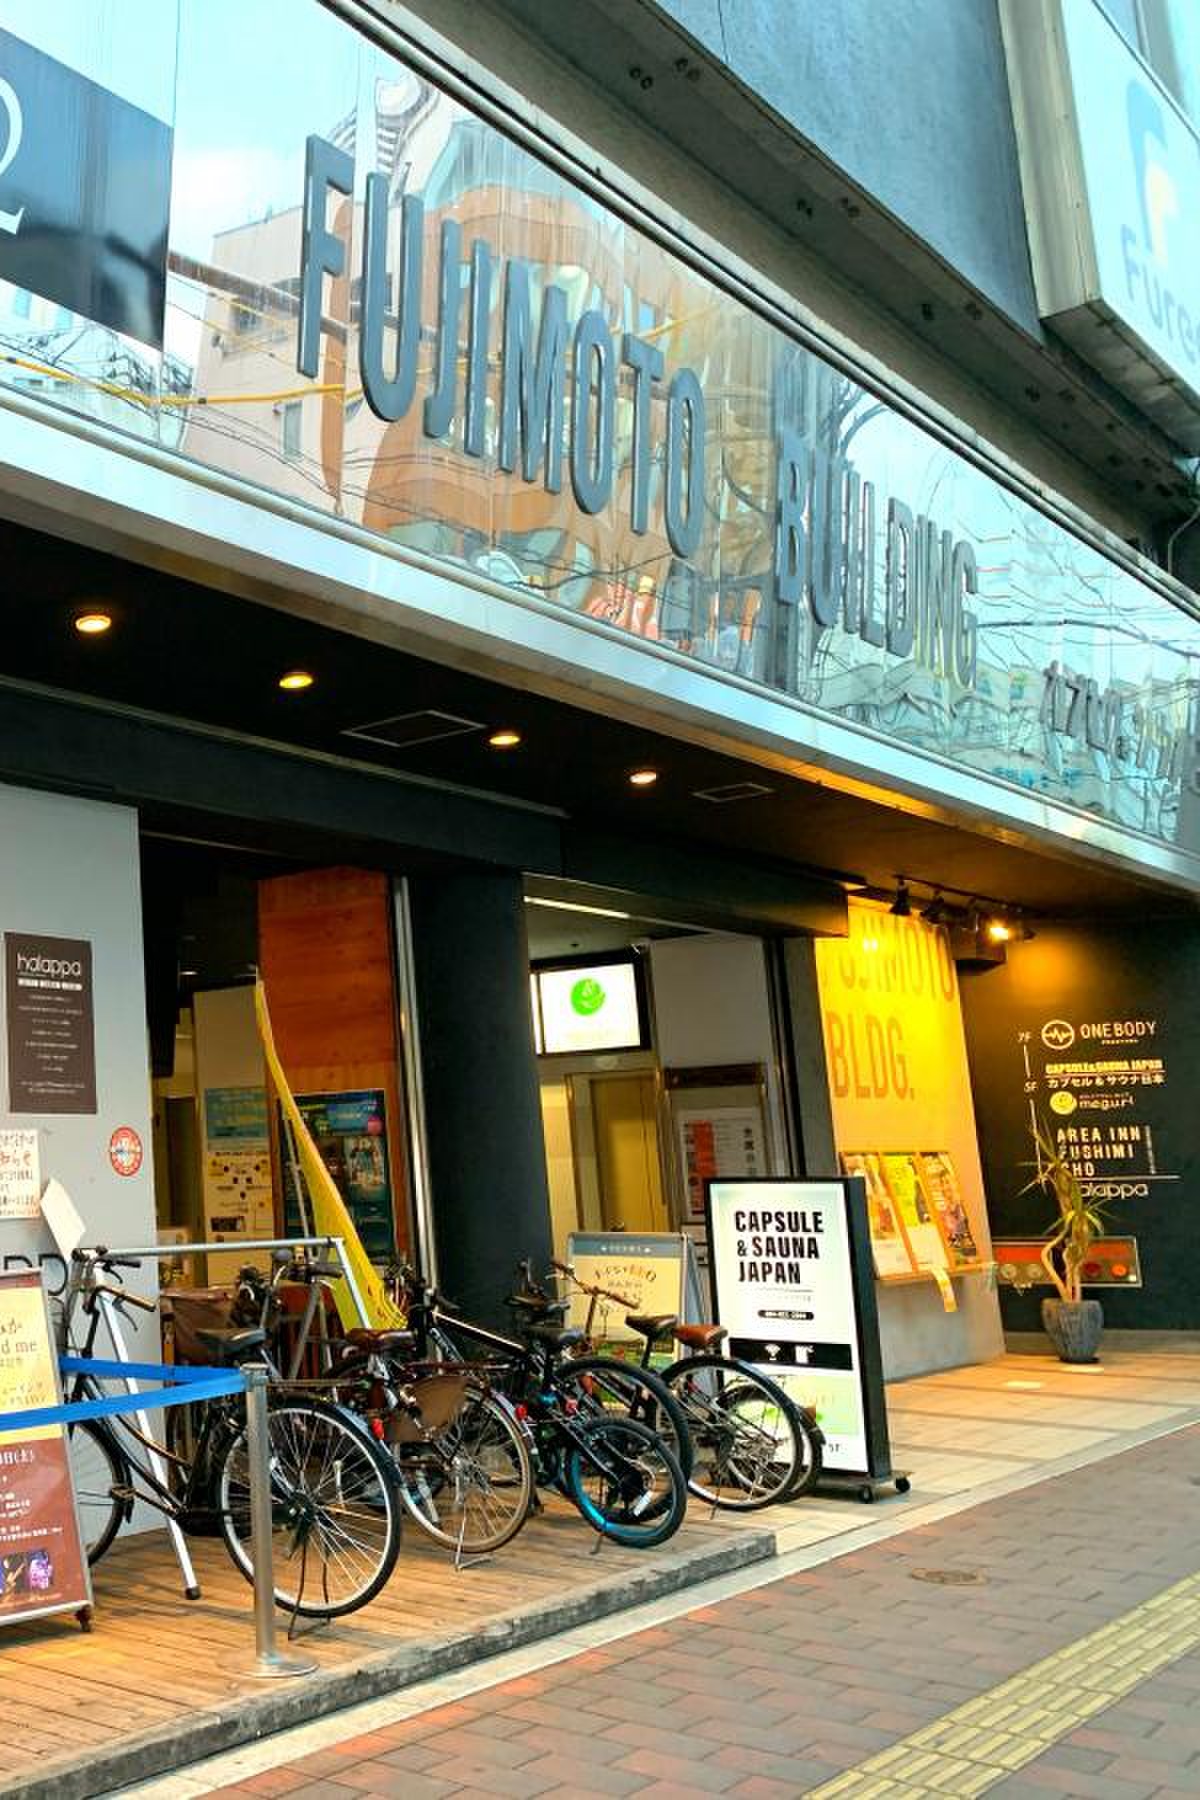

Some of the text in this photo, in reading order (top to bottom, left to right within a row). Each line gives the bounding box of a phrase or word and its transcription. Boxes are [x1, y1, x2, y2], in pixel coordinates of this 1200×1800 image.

[1119, 223, 1200, 366] Fure
[297, 133, 979, 692] FUJIMOTO BUILDING
[16, 952, 82, 979] halappa
[1079, 1020, 1158, 1040] ONEBODY
[1056, 1125, 1141, 1144] AREA INN
[1058, 1143, 1135, 1160] FUSHIMI
[1079, 1182, 1150, 1200] alappa
[734, 1210, 825, 1234] CAPSULE
[751, 1236, 821, 1260] SAUNA
[738, 1261, 801, 1285] JAPAN
[15, 1341, 38, 1353] me
